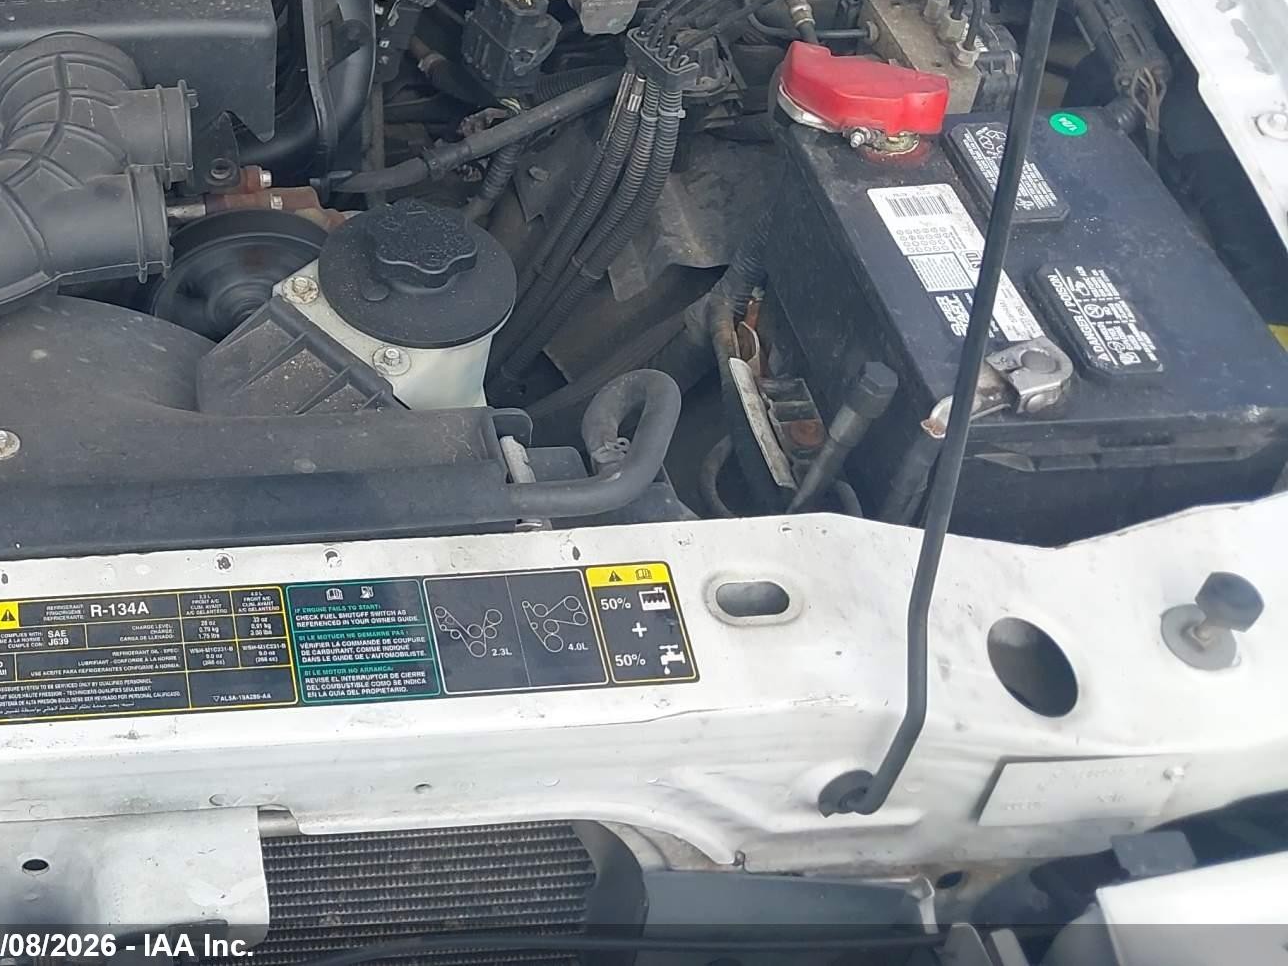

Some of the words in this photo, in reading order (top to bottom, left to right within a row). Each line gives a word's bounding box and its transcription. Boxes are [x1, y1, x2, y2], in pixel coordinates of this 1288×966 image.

[1047, 274, 1077, 307] POISON
[1073, 314, 1102, 354] DANGER
[90, 601, 150, 618] R-134A
[600, 597, 631, 611] 50%
[338, 611, 369, 619] SHUTOFF
[47, 629, 68, 638] SAE
[47, 637, 69, 646] J639
[342, 639, 381, 647] COMMANDE
[392, 636, 426, 644] COUPURE
[567, 642, 589, 651] 4.0L
[492, 647, 513, 656] 2.3L
[615, 653, 646, 667] 50%
[340, 673, 390, 682] INTERRUPTOR
[321, 681, 369, 690] COMBUSTIBLE
[403, 677, 427, 685] INDICA
